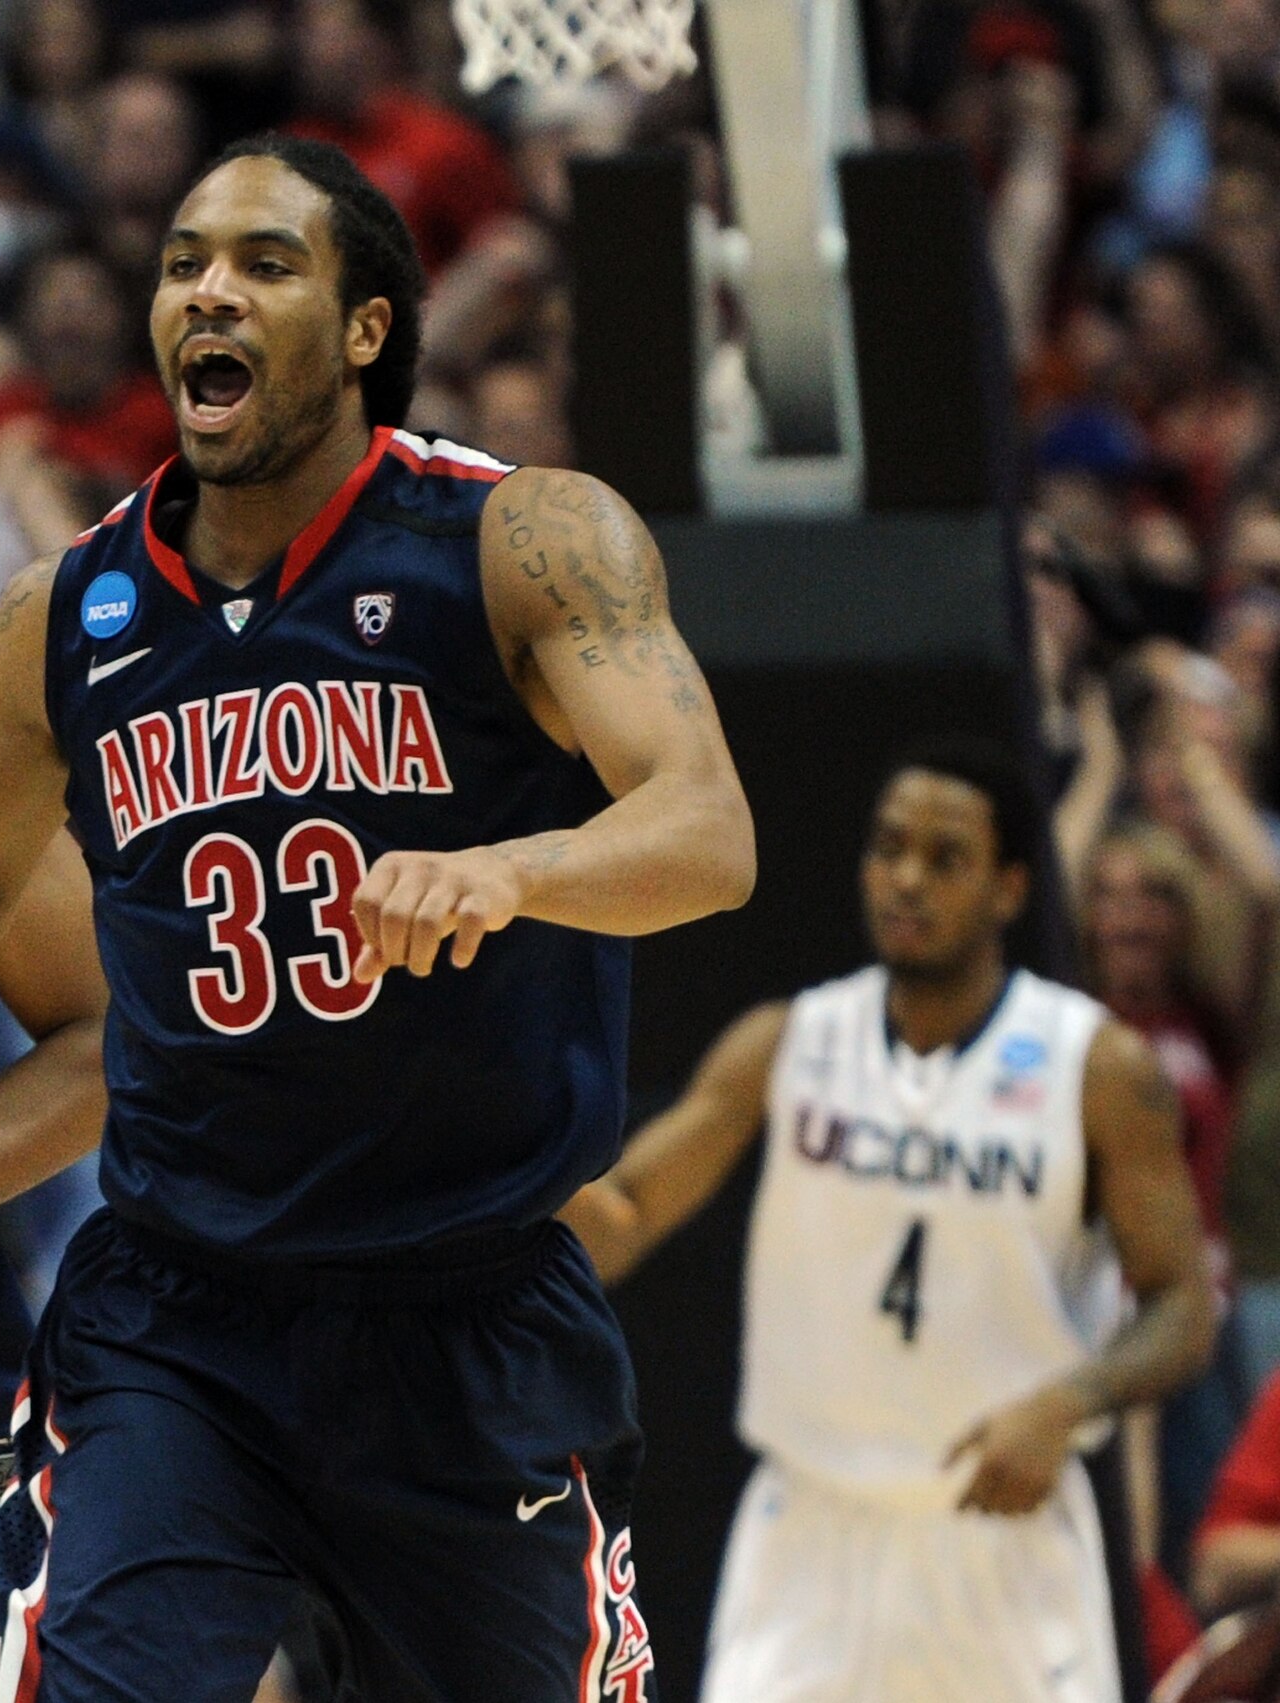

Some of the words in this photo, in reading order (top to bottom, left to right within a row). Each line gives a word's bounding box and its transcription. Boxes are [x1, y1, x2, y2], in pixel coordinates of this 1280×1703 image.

[87, 600, 128, 622] NCAA
[501, 504, 607, 668] LOUISE
[96, 680, 454, 851] ARIZONA
[183, 818, 383, 1036] 33
[794, 1098, 1044, 1197] UCONN
[880, 1216, 927, 1343] 4
